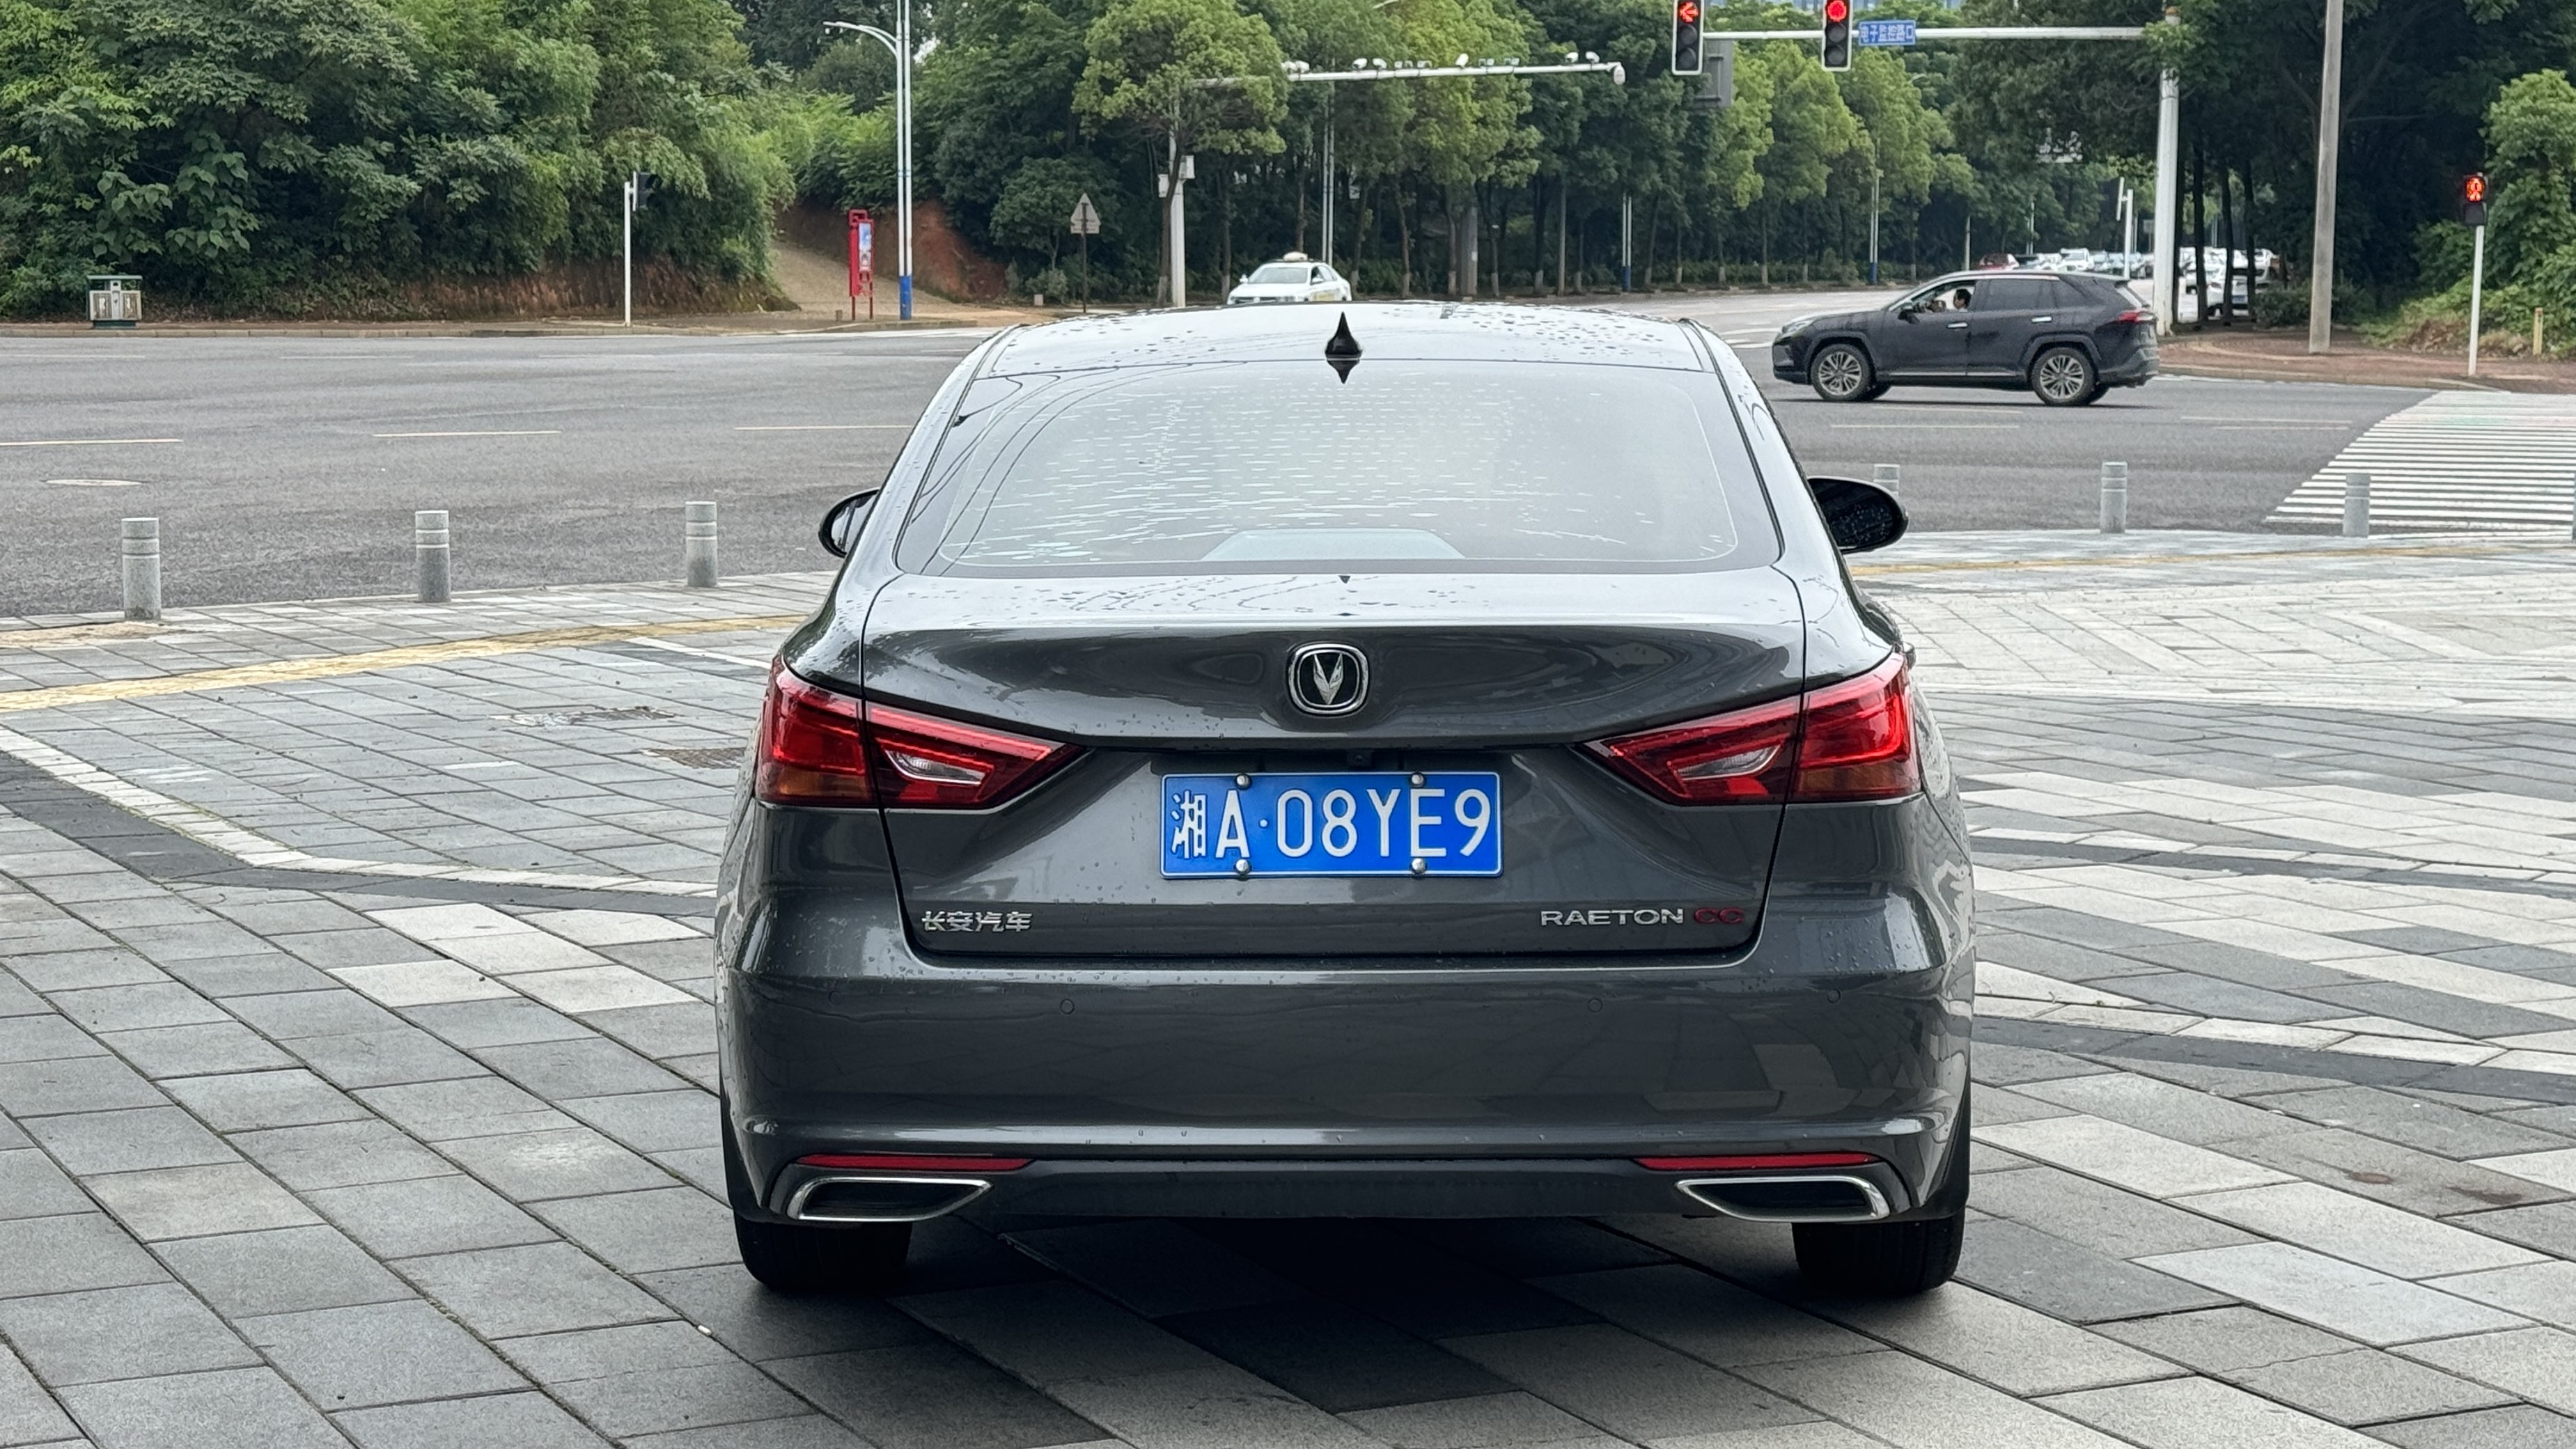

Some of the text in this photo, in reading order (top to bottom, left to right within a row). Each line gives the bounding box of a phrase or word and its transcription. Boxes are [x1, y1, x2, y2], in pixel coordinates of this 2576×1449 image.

[921, 911, 1033, 932] 长安汽车
[1540, 907, 1744, 925] RAETON CC
